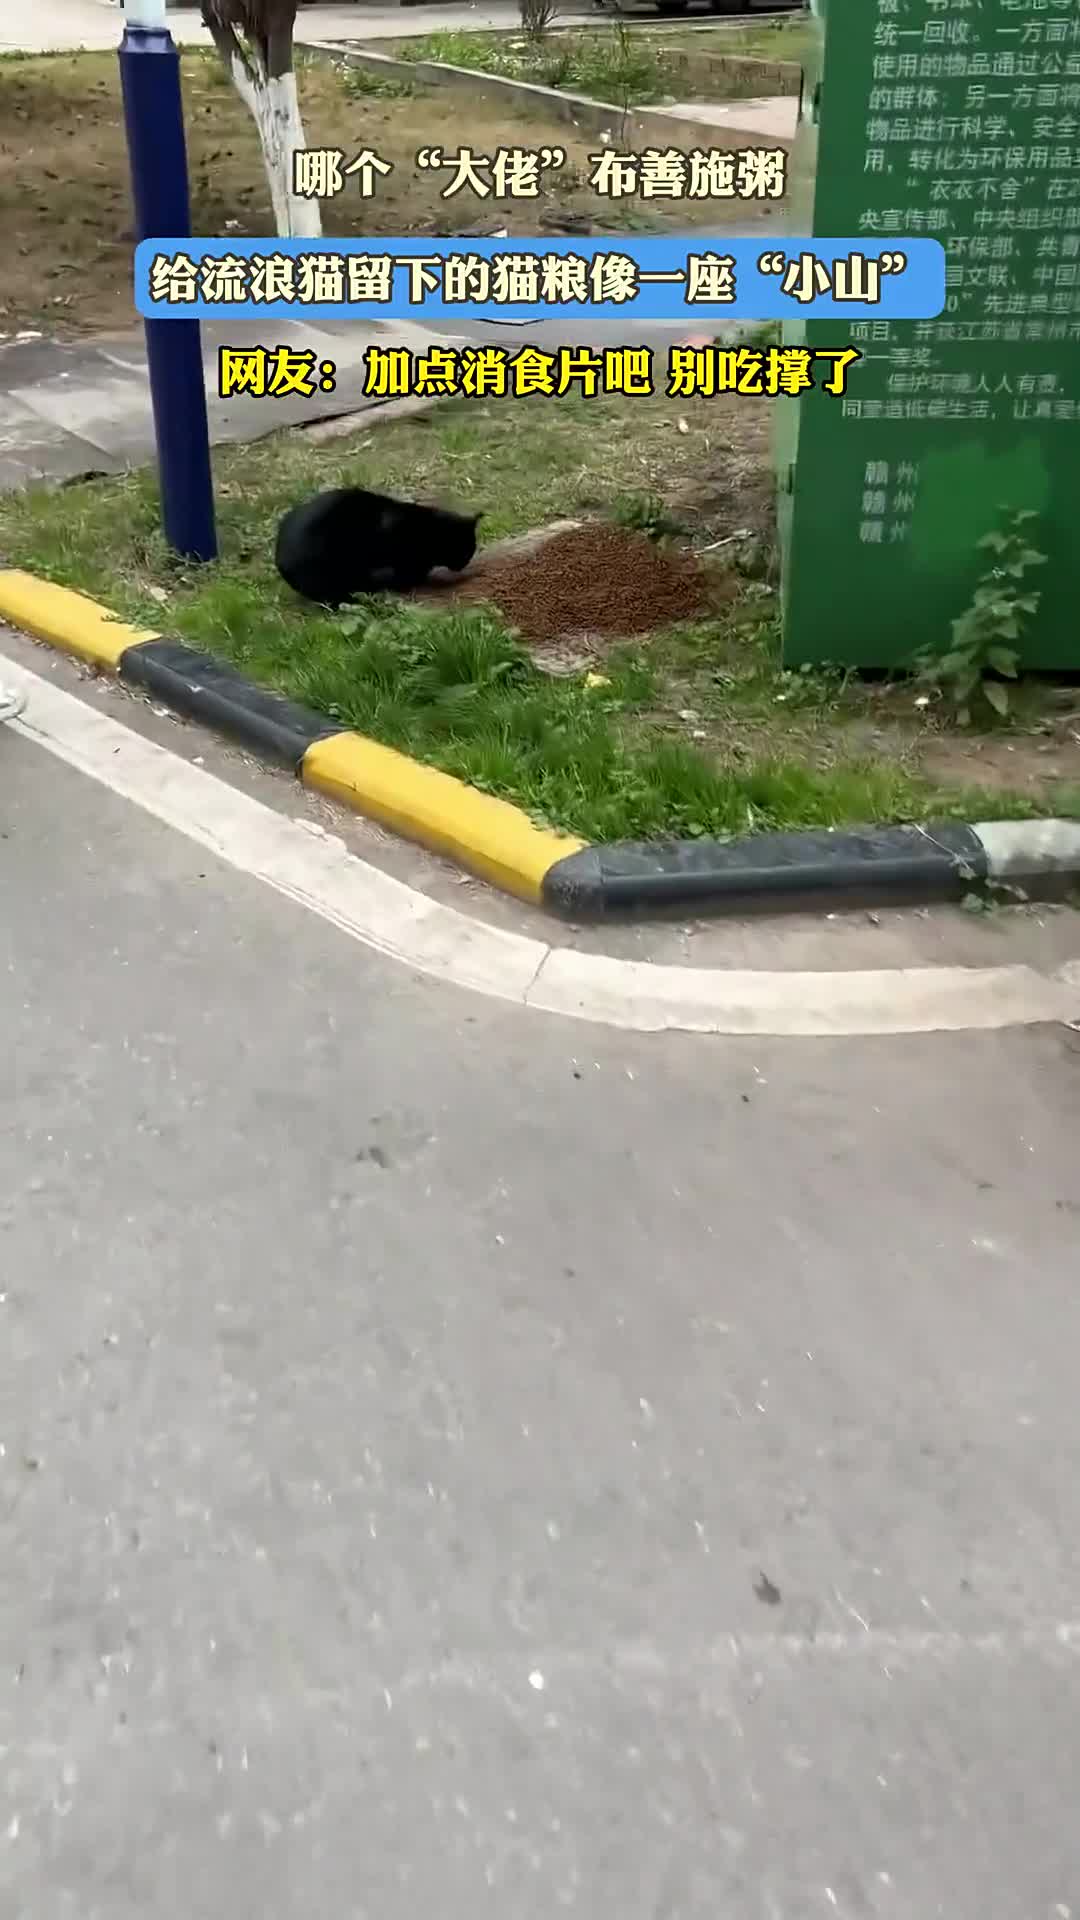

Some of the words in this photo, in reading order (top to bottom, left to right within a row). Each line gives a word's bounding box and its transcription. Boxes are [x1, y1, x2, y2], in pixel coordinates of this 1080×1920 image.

[865, 113, 1080, 142] 物品进行科学、安全
